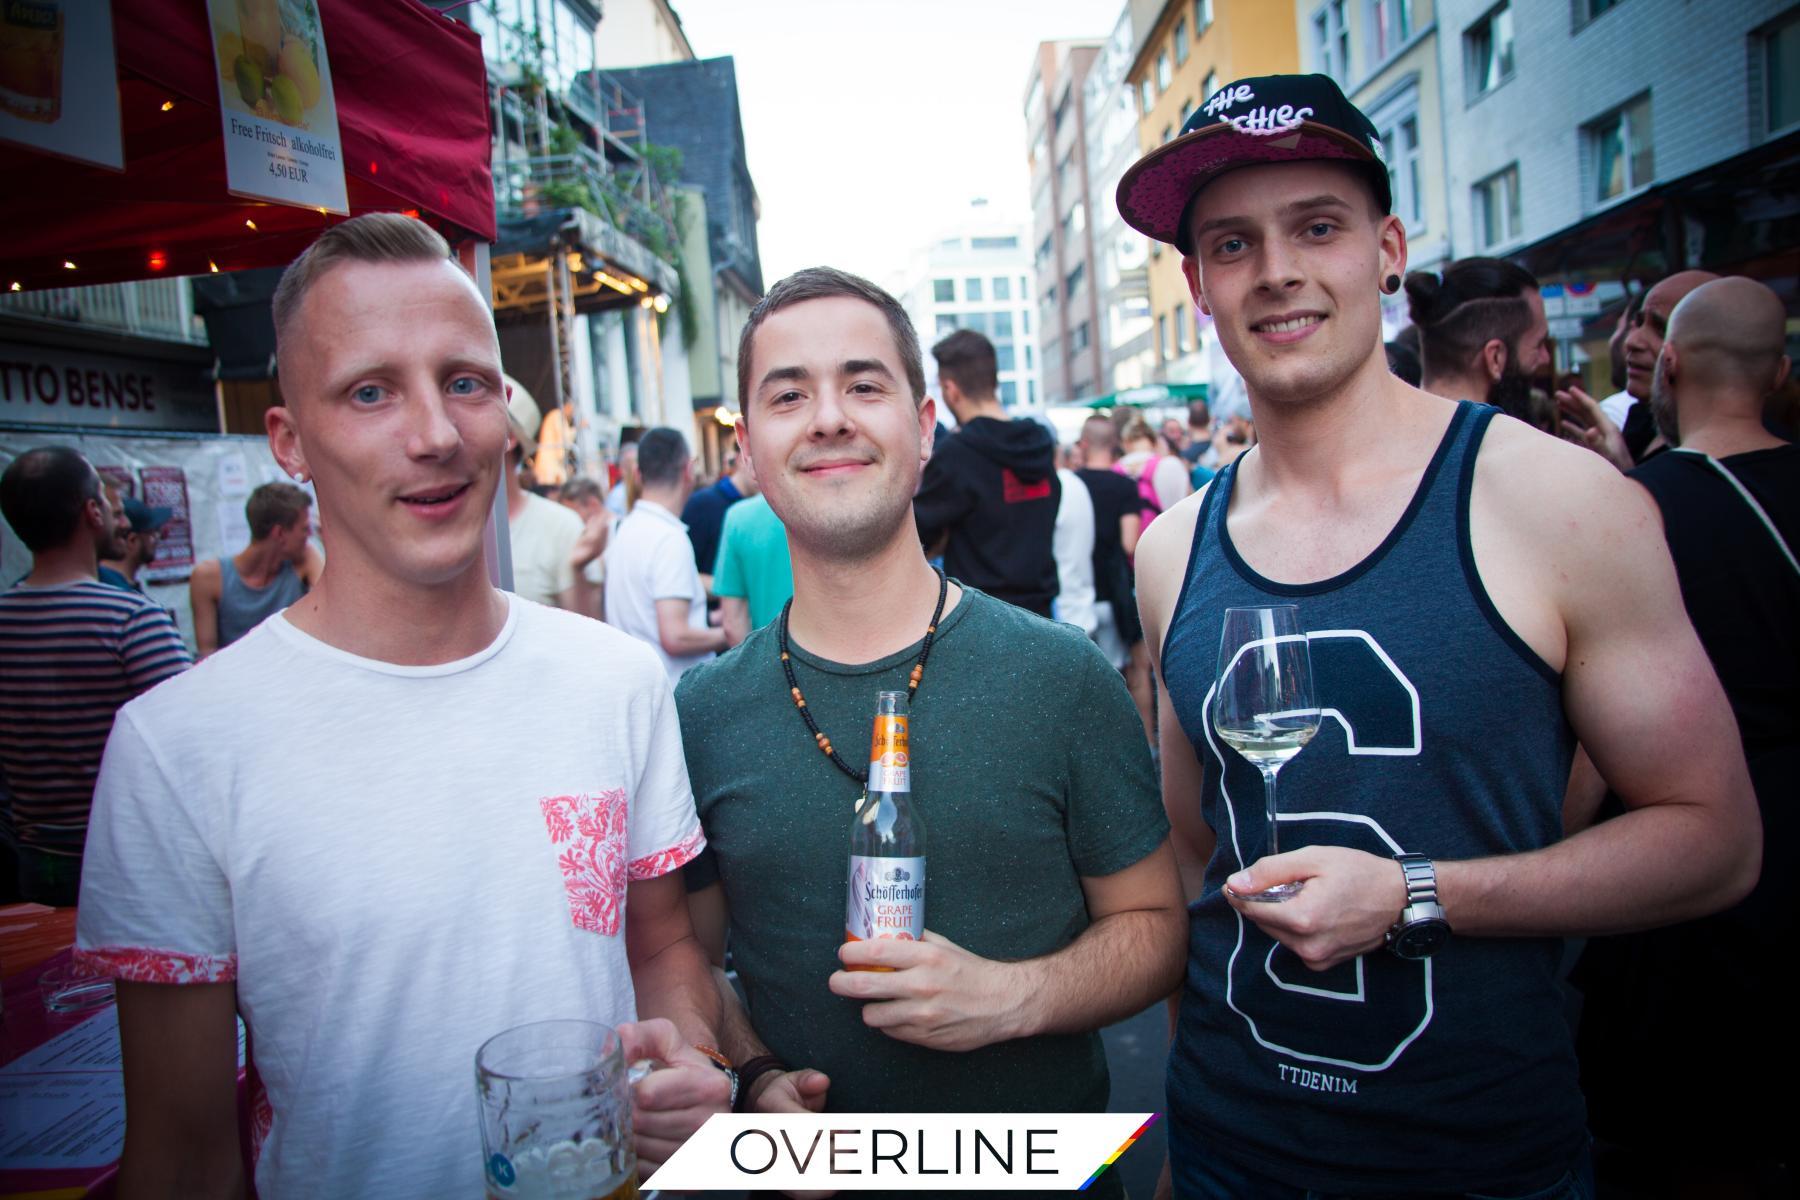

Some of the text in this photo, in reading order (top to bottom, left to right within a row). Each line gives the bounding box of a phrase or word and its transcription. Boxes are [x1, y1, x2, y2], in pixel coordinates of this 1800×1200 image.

[230, 118, 254, 139] Free
[255, 125, 287, 148] Fritsch
[291, 136, 336, 161] alkoholfrei
[268, 161, 309, 183] 4,50 EUR
[65, 366, 156, 412] BENSE
[864, 881, 923, 902] Schöfferhofer
[877, 904, 913, 915] GRAPE
[877, 915, 913, 928] FRUIT
[1278, 1063, 1358, 1094] TTDENIM
